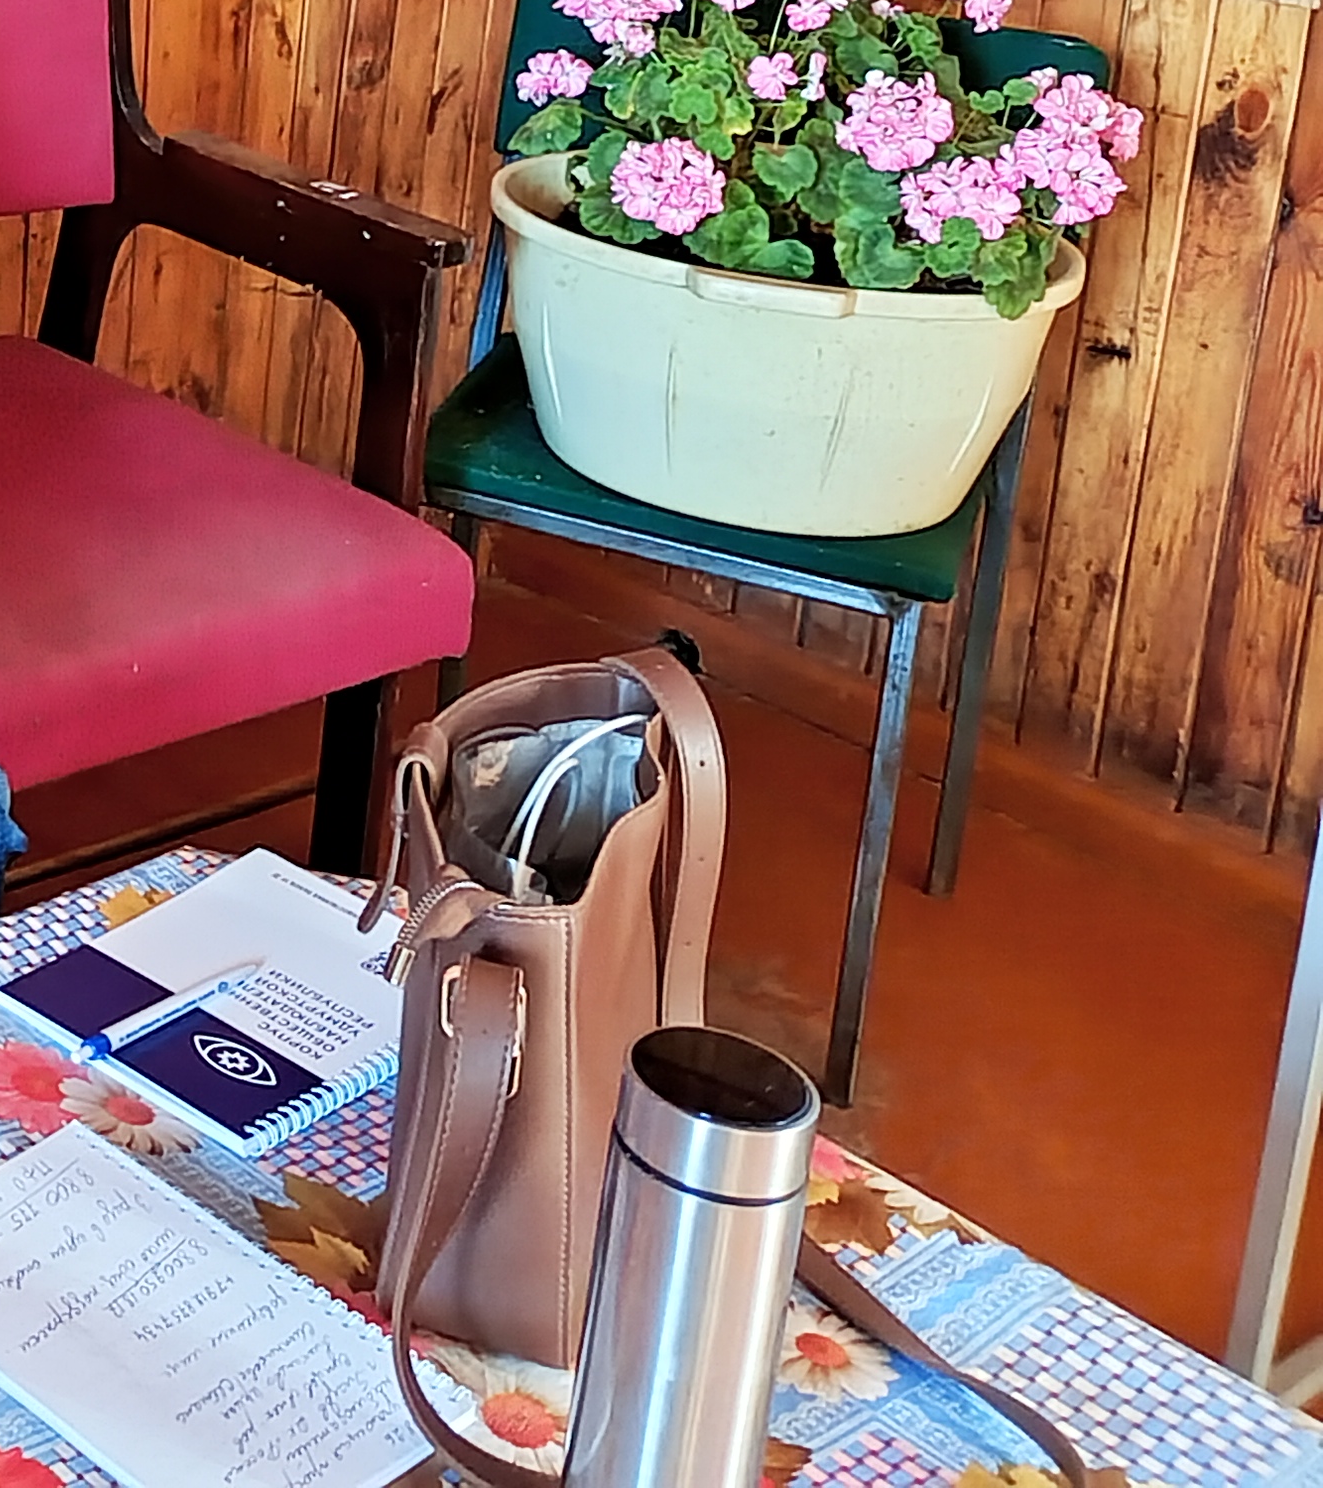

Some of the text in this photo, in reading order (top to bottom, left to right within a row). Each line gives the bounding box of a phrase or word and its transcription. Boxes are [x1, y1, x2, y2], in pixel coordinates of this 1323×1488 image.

[228, 989, 336, 1053] ОБЩЕСТВЕНН
[240, 983, 349, 1045] НАБЛЮДАТЕЛ
[255, 976, 360, 1037] УДМУРТСКОЙ
[268, 969, 376, 1029] РЕСПУБЛИКИ
[257, 1021, 323, 1060] КОРПУС
